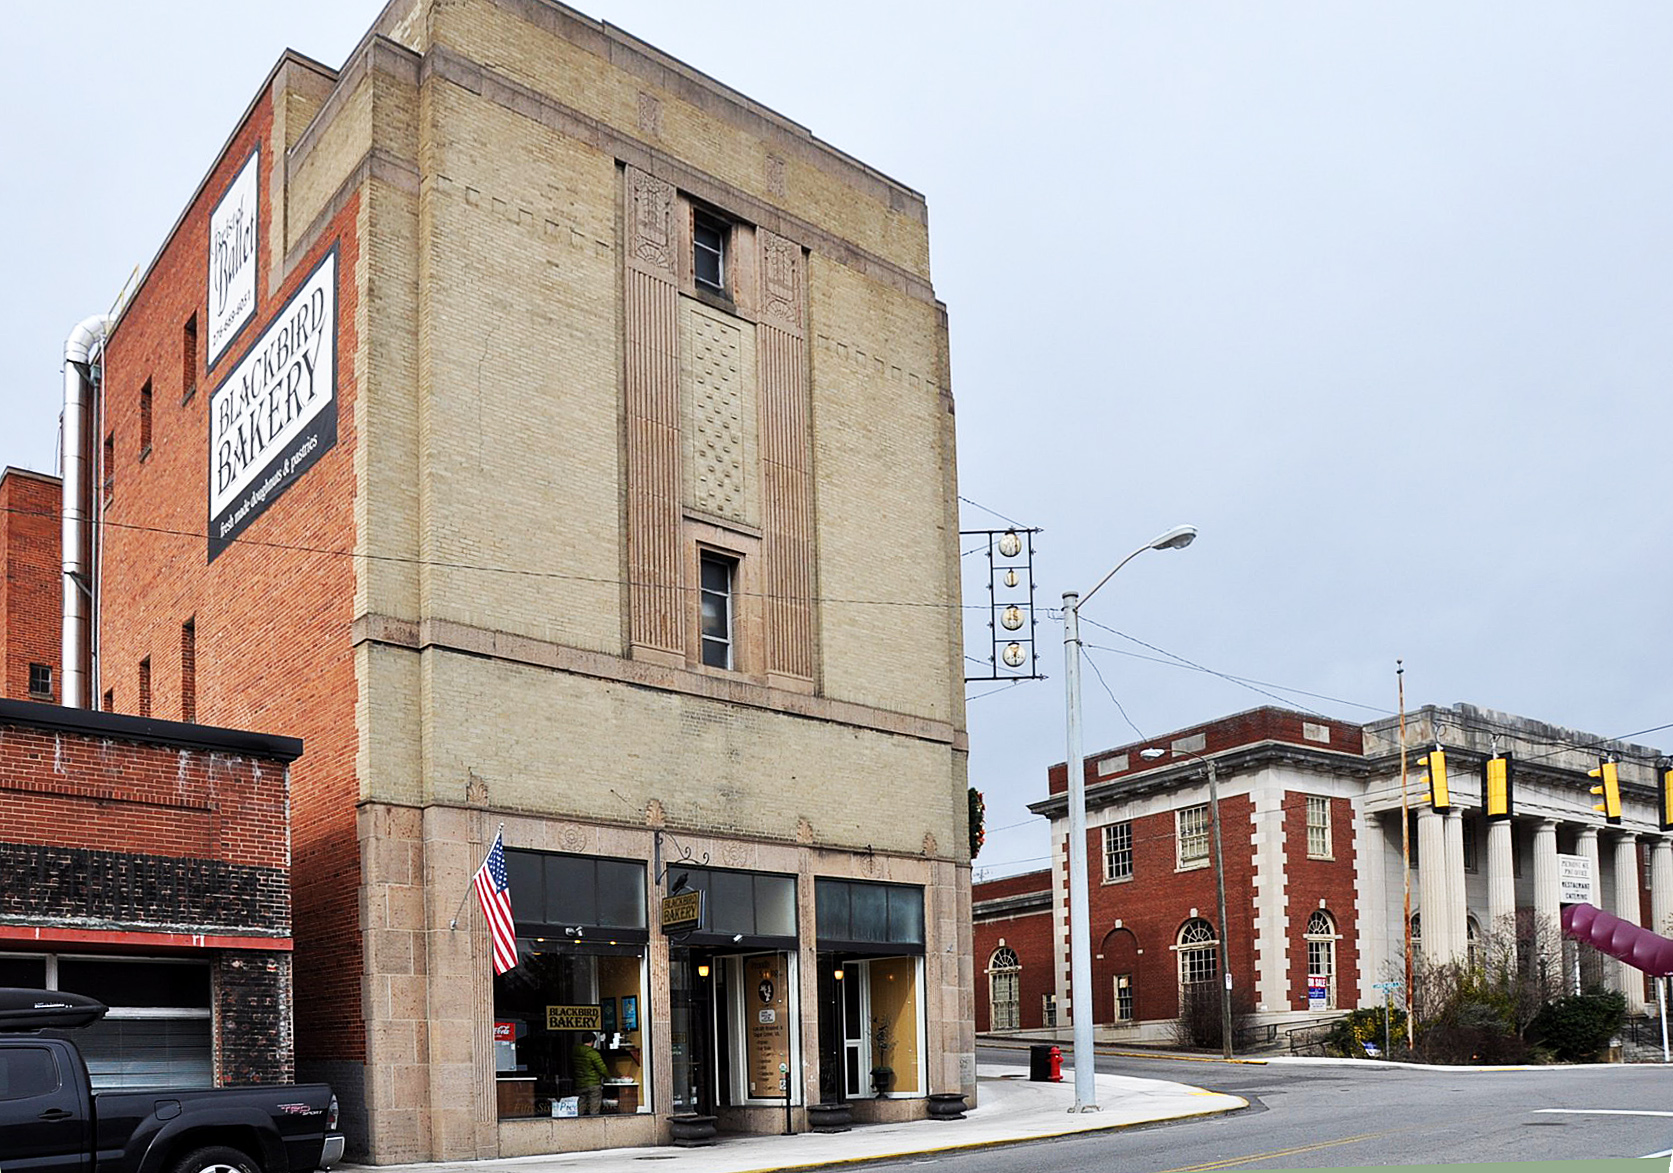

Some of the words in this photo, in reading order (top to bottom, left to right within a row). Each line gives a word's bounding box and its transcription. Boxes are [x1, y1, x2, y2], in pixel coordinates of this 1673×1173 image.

[213, 208, 255, 317] Ballet
[217, 287, 324, 440] BLACKBIRD
[216, 313, 327, 496] BAKERY
[219, 513, 235, 538] fresh
[234, 499, 250, 524] made
[250, 469, 283, 508] doughnuts
[289, 434, 318, 474] pastries
[1561, 881, 1590, 890] RESTAURANT
[664, 893, 698, 909] BLACKBIRD
[1565, 891, 1588, 900] CATERING
[664, 904, 697, 923] BAKERY
[549, 1007, 599, 1017] BLACKBIRD
[549, 1015, 600, 1028] BAKERY
